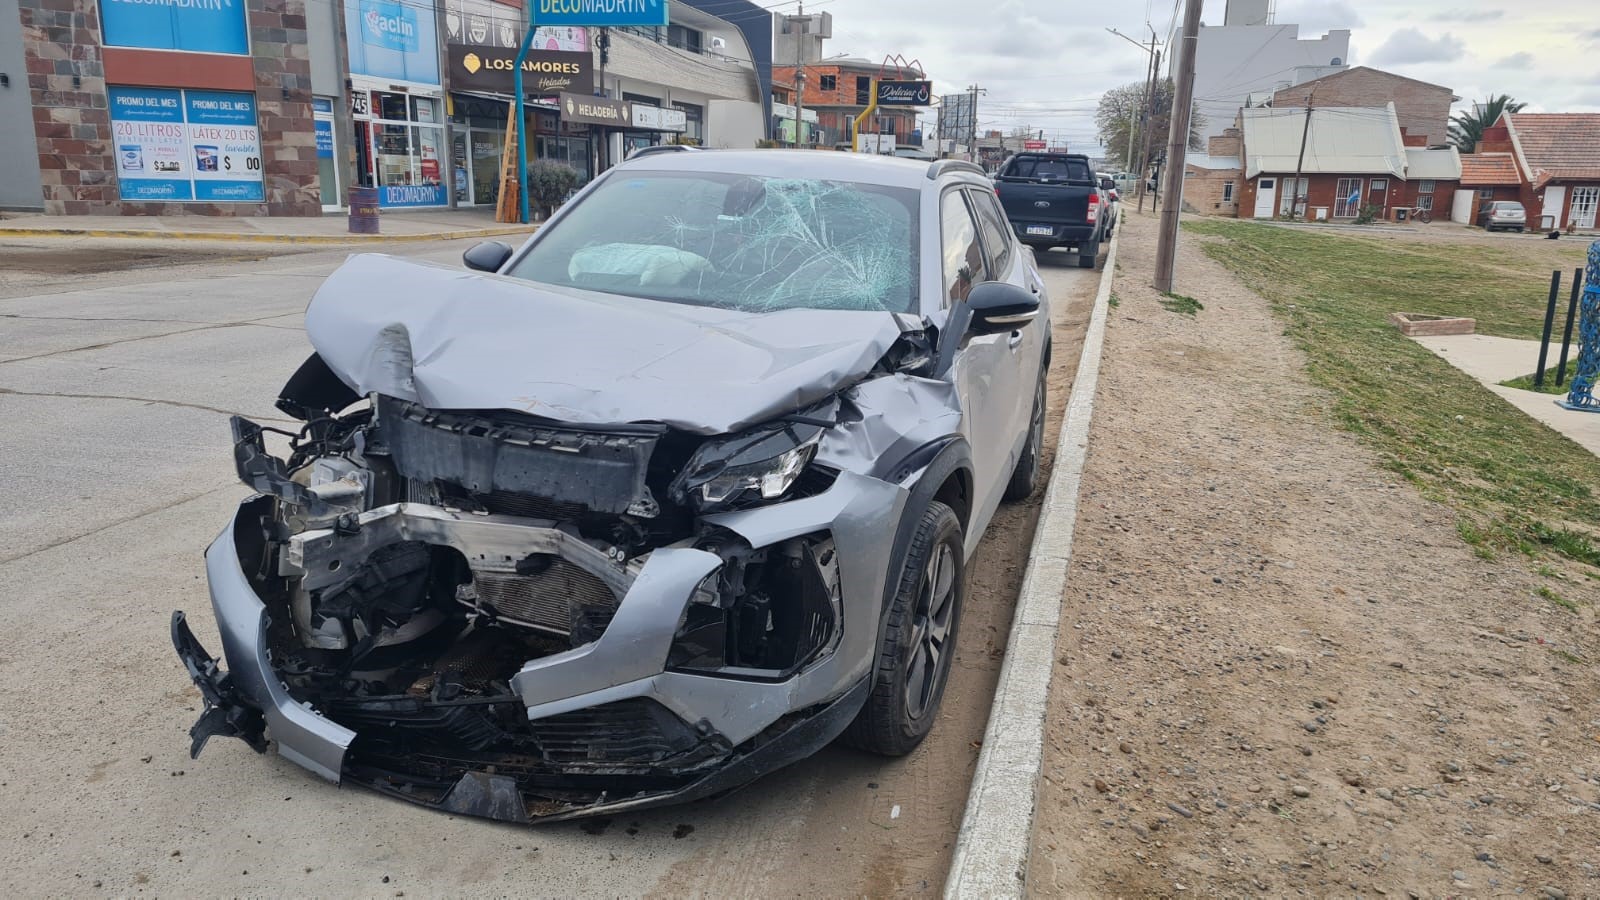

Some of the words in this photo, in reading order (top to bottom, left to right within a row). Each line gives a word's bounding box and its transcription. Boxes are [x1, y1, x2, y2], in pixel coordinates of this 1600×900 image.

[112, 0, 222, 10] ADRYN
[541, 0, 646, 13] DECOMADRYN
[485, 58, 514, 70] LOS
[520, 60, 580, 74] AMORES
[538, 76, 571, 87] Helados
[117, 96, 144, 106] PROMO
[145, 98, 160, 106] DEL
[161, 99, 177, 108] MES
[192, 100, 218, 109] PROMO
[219, 101, 234, 110] DEL
[234, 102, 250, 111] MES
[117, 122, 132, 136] 20
[138, 123, 182, 138] LITROS
[224, 129, 237, 140] 20
[240, 129, 256, 141] LTS
[246, 157, 260, 170] 00
[387, 186, 435, 203] DECOMADRYN
